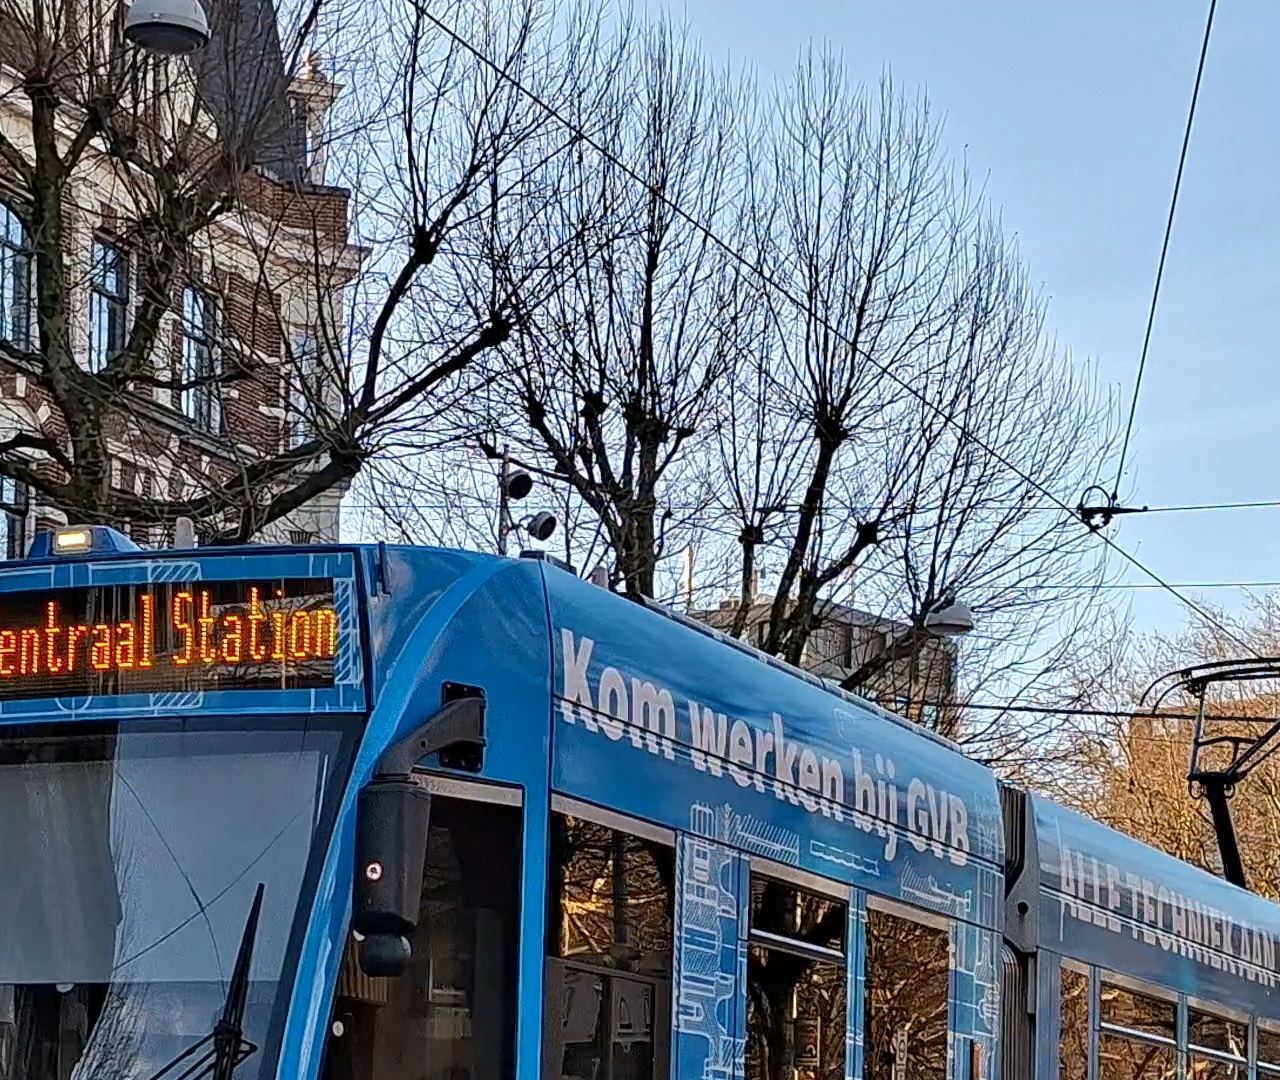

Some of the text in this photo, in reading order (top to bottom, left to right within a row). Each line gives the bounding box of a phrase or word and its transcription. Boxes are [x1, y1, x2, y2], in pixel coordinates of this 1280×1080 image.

[173, 586, 337, 664] Station
[560, 628, 971, 867] Kom werken bij GVB
[1061, 849, 1121, 933] ALLE
[1126, 871, 1236, 976] TECHNIEK
